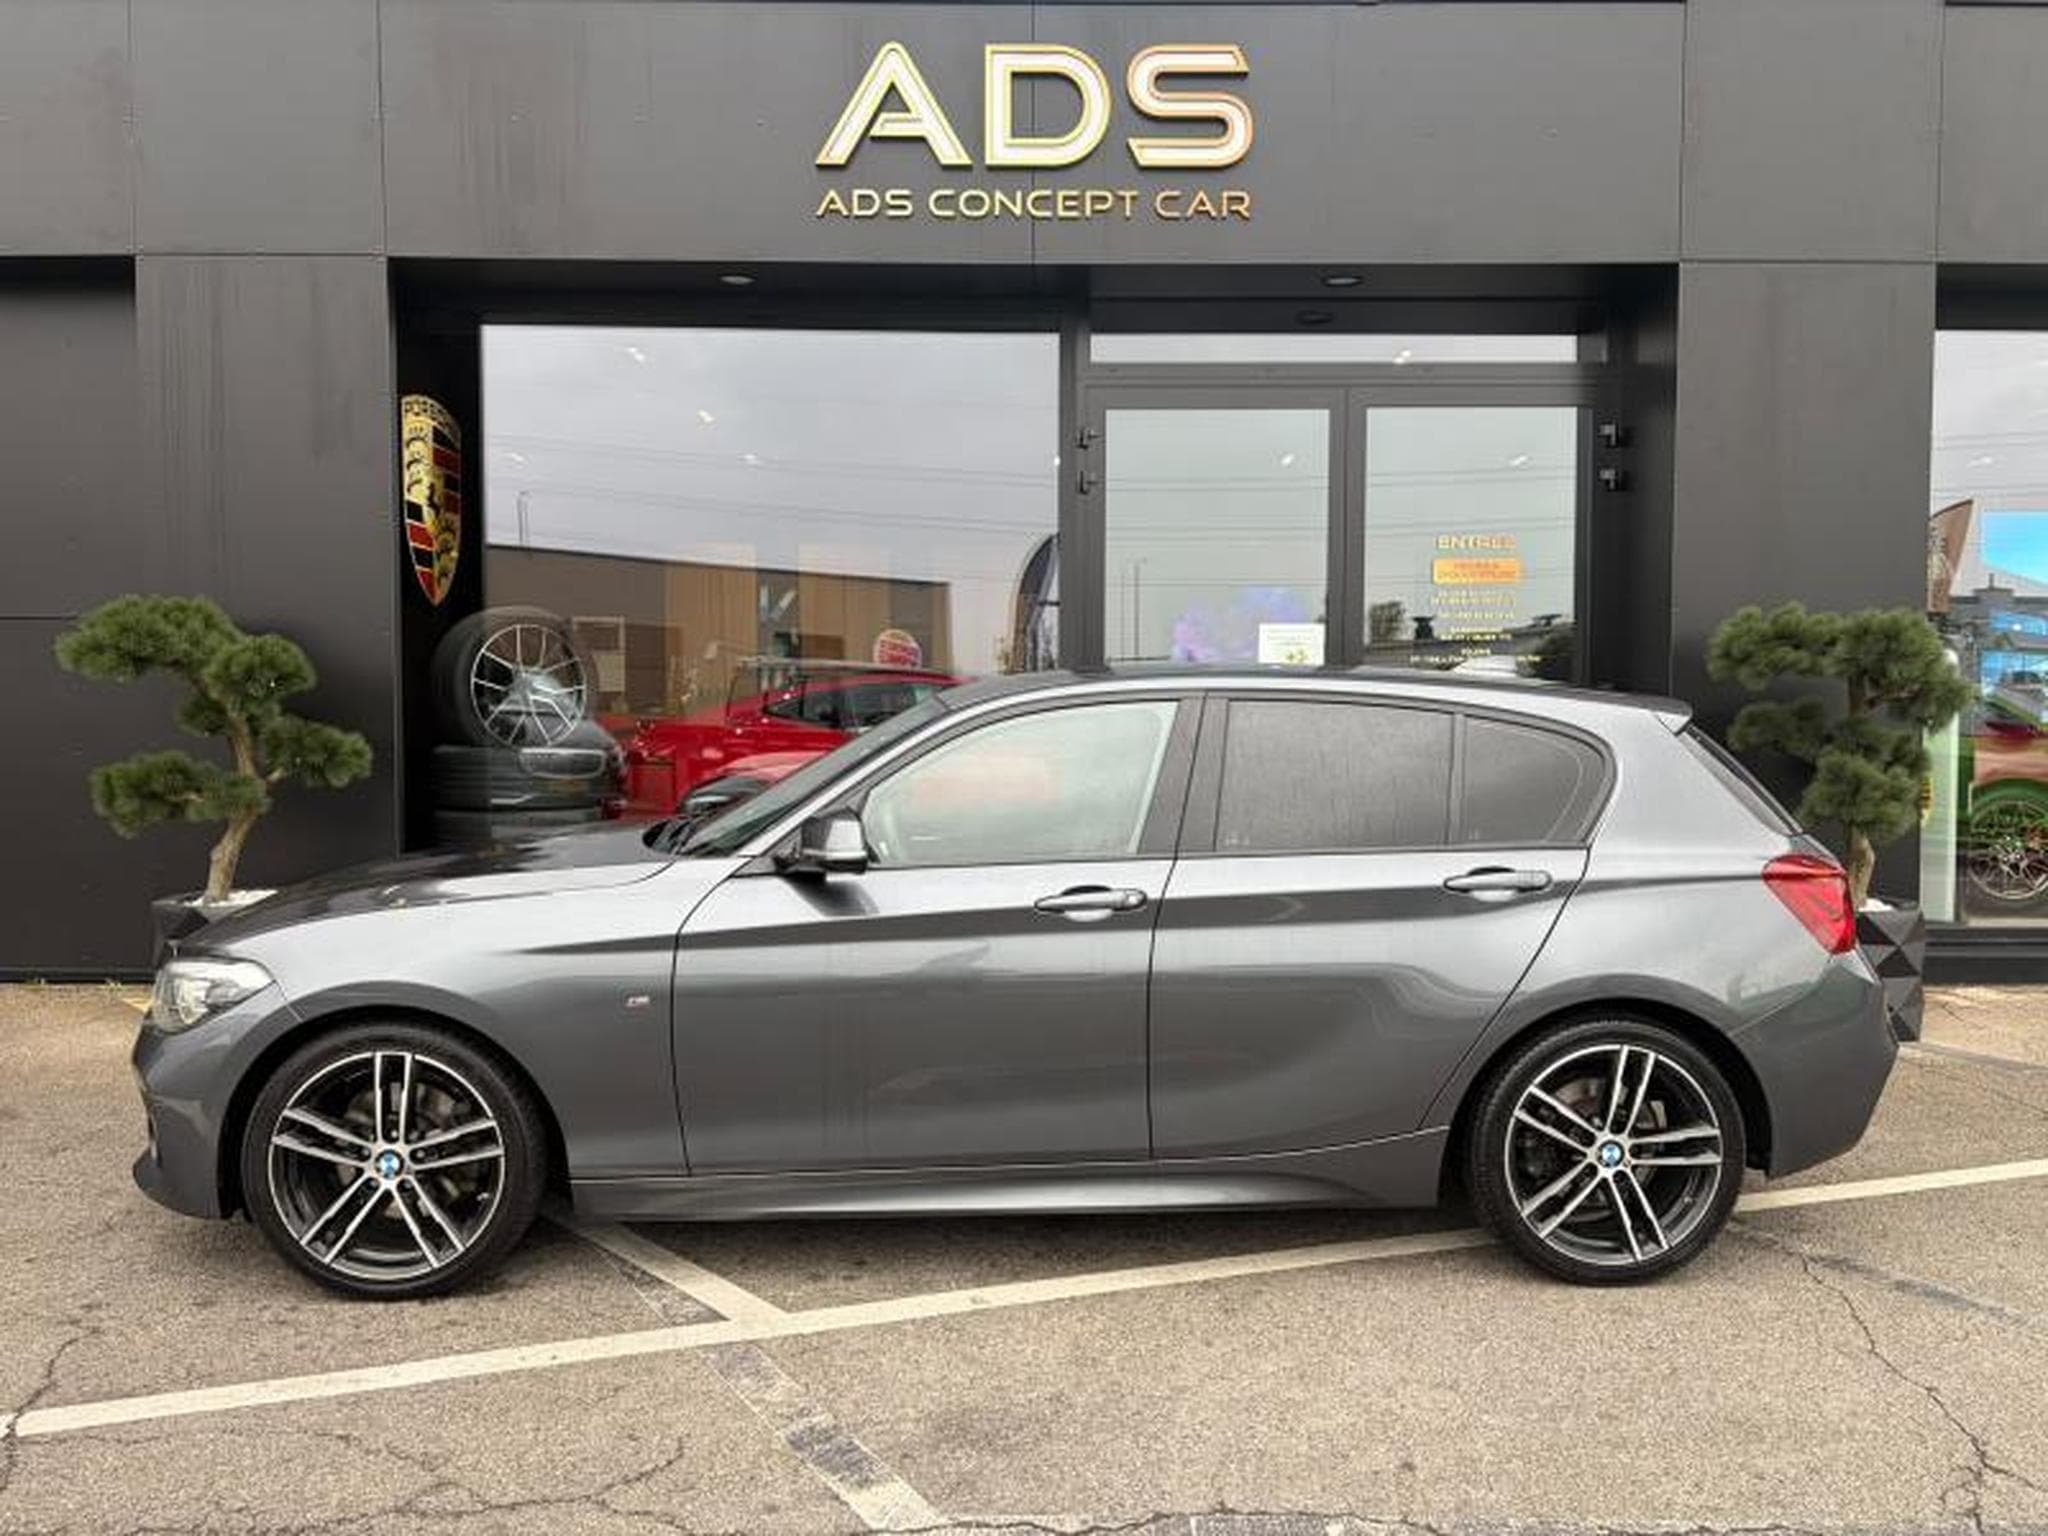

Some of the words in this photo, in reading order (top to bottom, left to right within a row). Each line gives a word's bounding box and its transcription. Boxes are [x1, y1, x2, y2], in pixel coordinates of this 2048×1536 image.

[815, 41, 1254, 167] ADS
[816, 189, 914, 217] ADS
[928, 189, 1139, 218] CONCEPT
[1155, 190, 1251, 218] CAR
